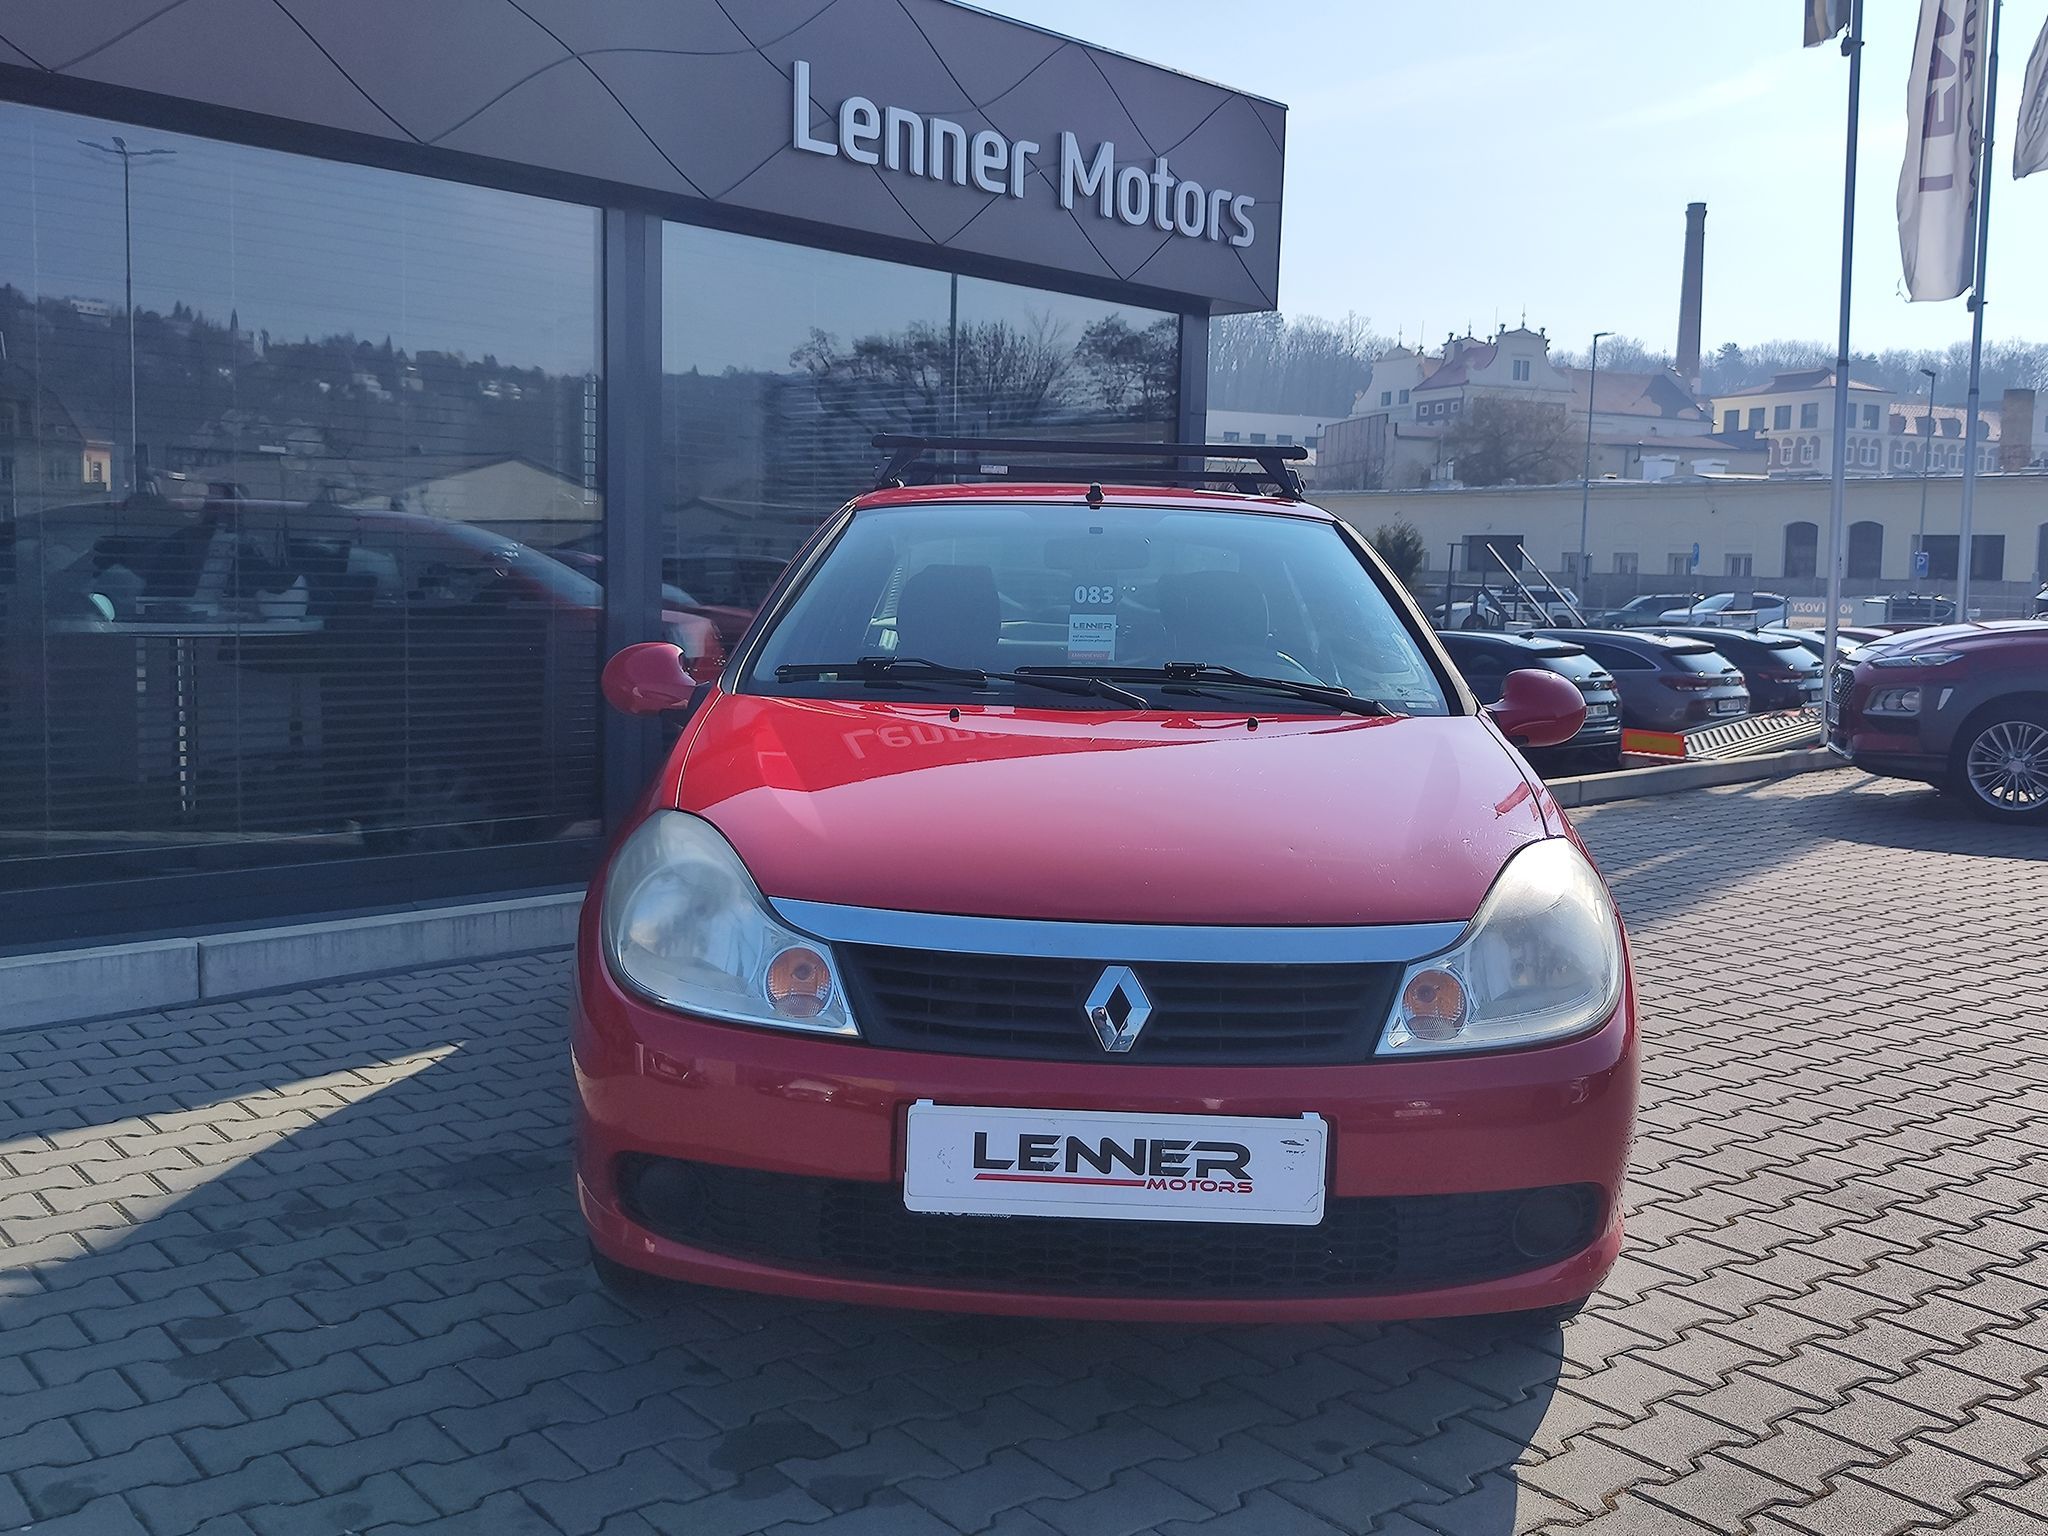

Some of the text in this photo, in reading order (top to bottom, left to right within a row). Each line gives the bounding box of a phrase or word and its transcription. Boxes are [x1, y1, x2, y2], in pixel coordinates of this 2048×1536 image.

[793, 60, 1256, 248] Lenner Motors
[1074, 585, 1115, 604] 083
[1072, 621, 1113, 631] LENNER
[973, 1131, 1253, 1180] LENNER
[1145, 1178, 1253, 1194] MOTORS
